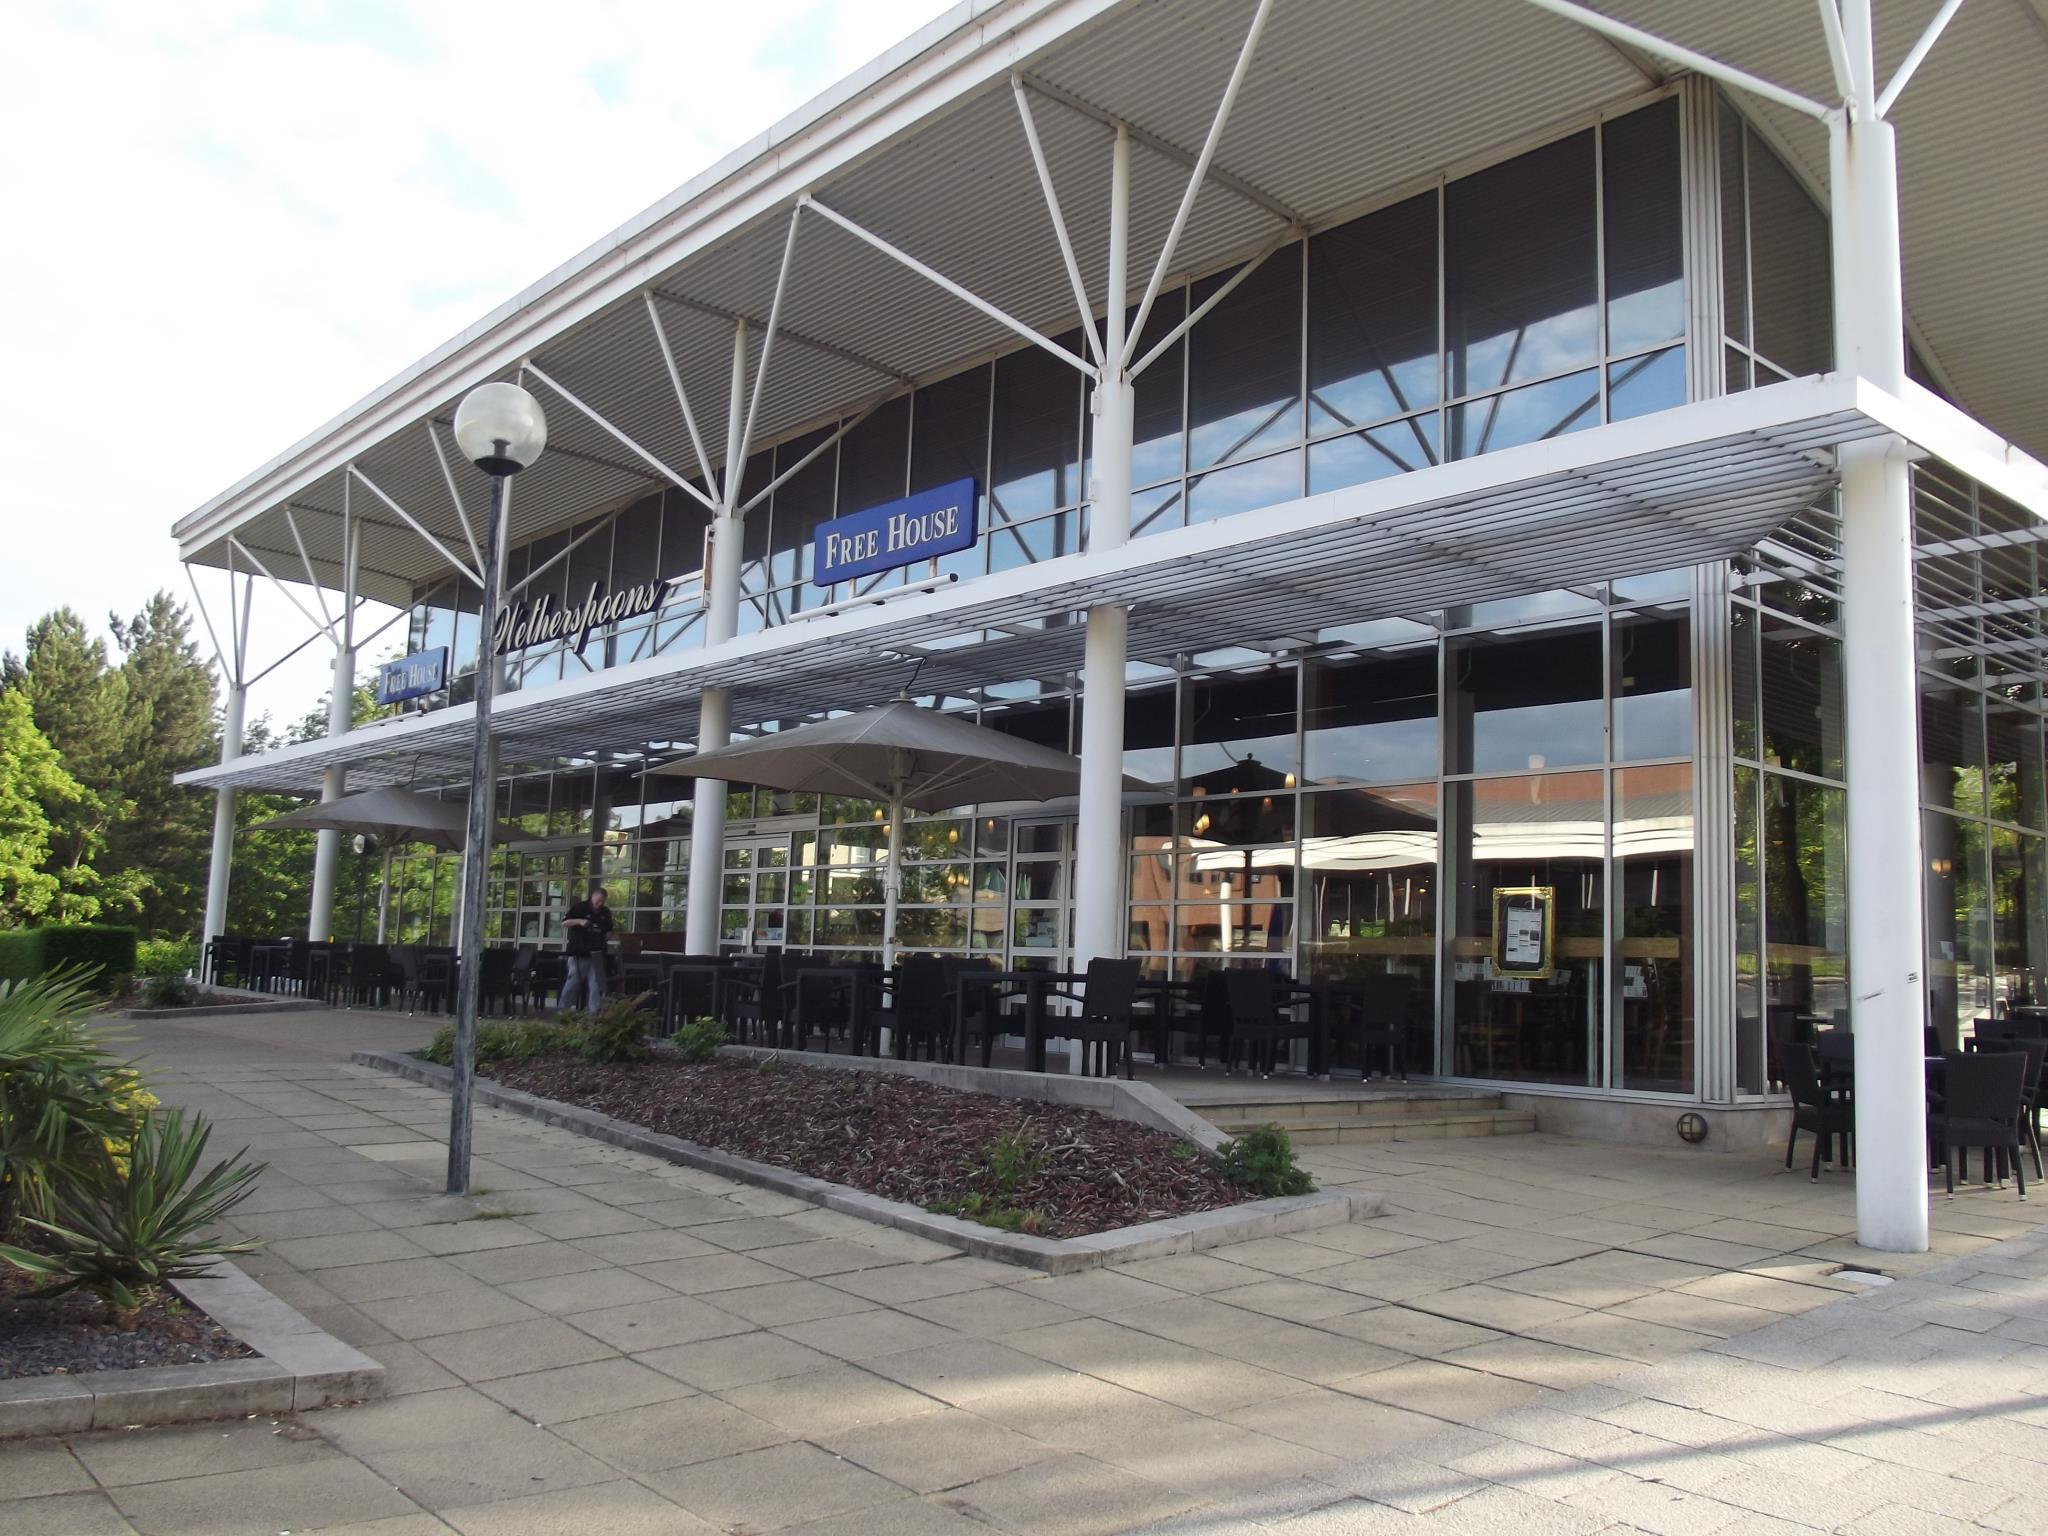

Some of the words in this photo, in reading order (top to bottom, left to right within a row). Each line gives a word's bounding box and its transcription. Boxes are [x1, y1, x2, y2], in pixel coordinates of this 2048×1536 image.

[825, 529, 879, 569] FREE
[886, 506, 959, 552] HOUSE
[494, 579, 663, 656] Wetherspoons
[384, 671, 408, 695] FREE
[409, 663, 438, 688] HOUSE
